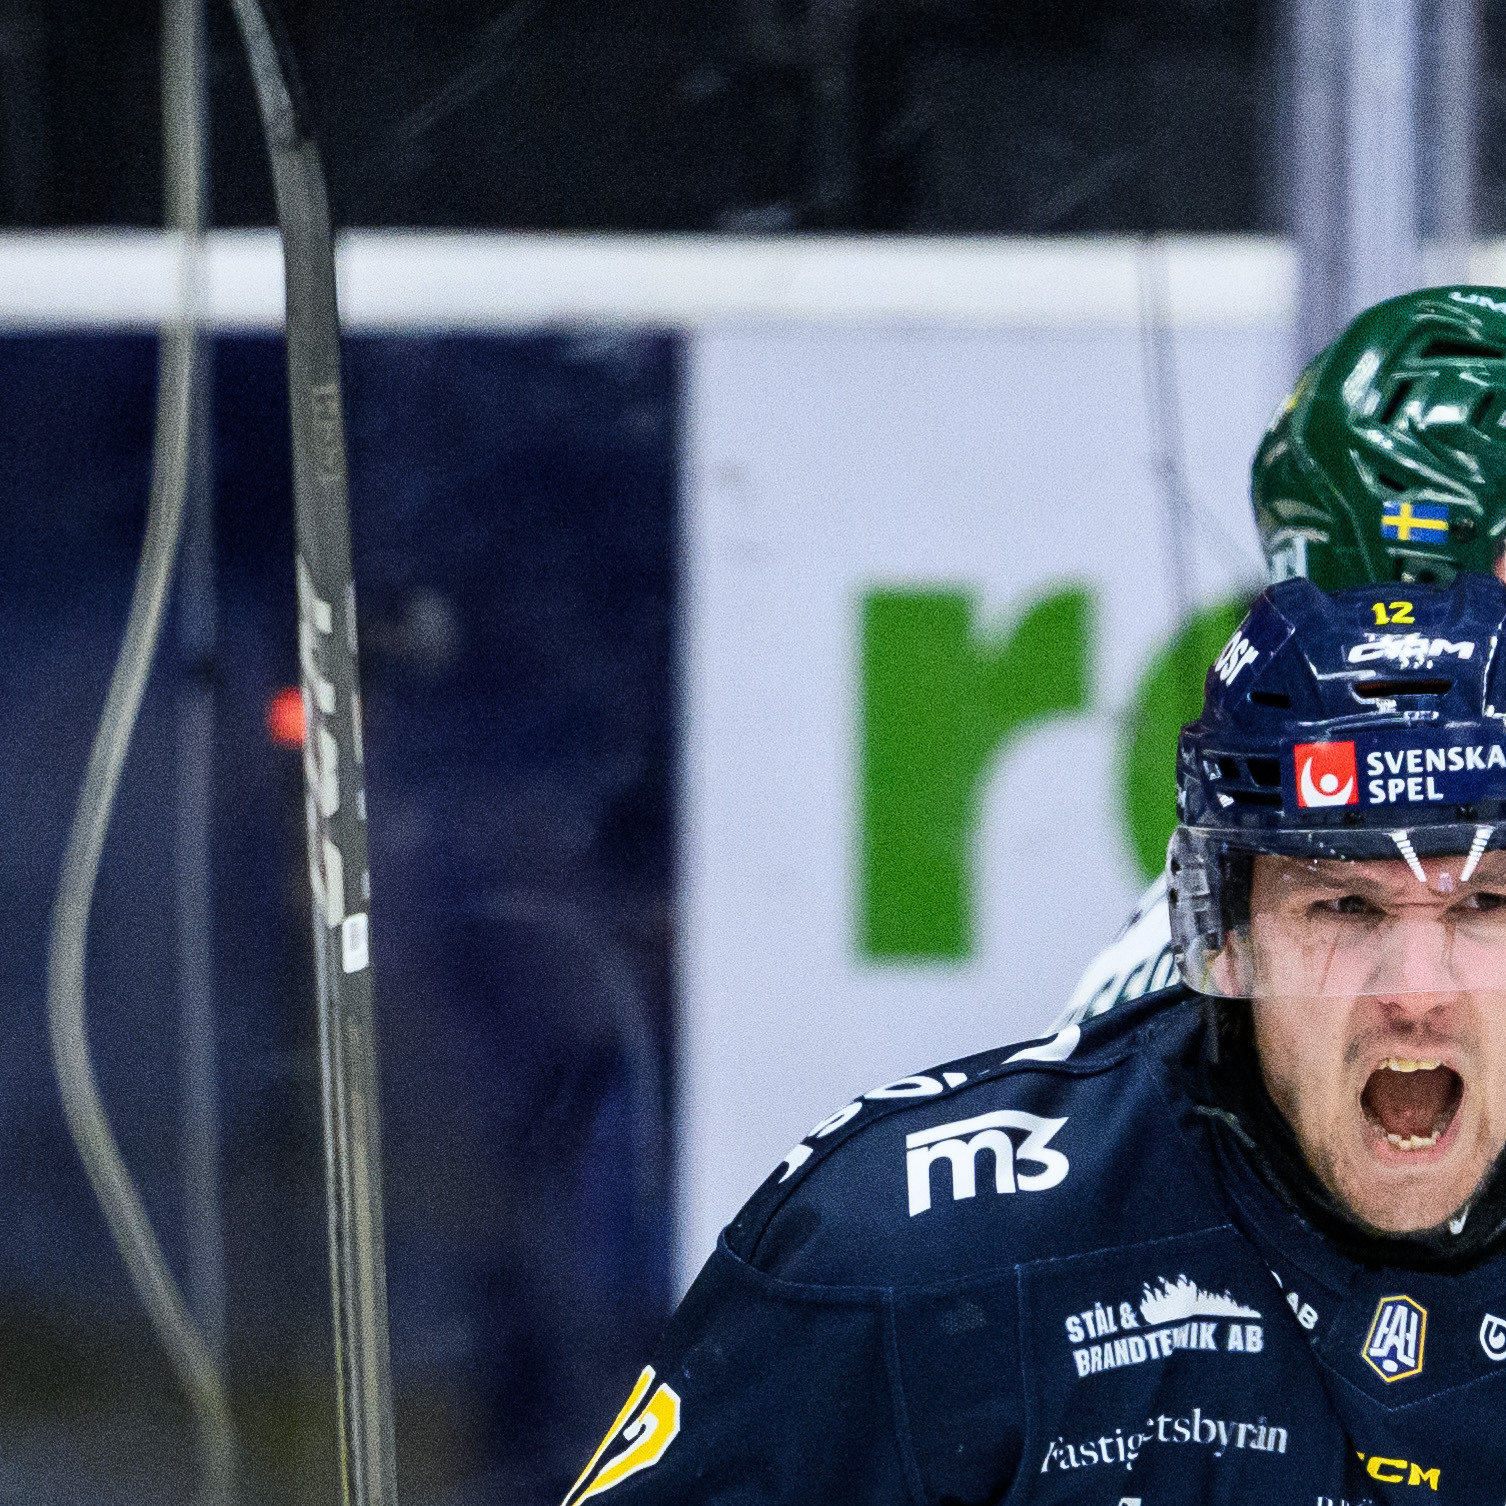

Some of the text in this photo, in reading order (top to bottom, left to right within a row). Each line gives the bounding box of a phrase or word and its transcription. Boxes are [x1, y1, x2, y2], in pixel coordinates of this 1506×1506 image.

[1371, 601, 1416, 626] 12
[1368, 776, 1445, 804] SPEL
[1064, 1300, 1139, 1344] STÅL &
[1226, 1323, 1265, 1353] AB
[1356, 1450, 1441, 1491] CM
